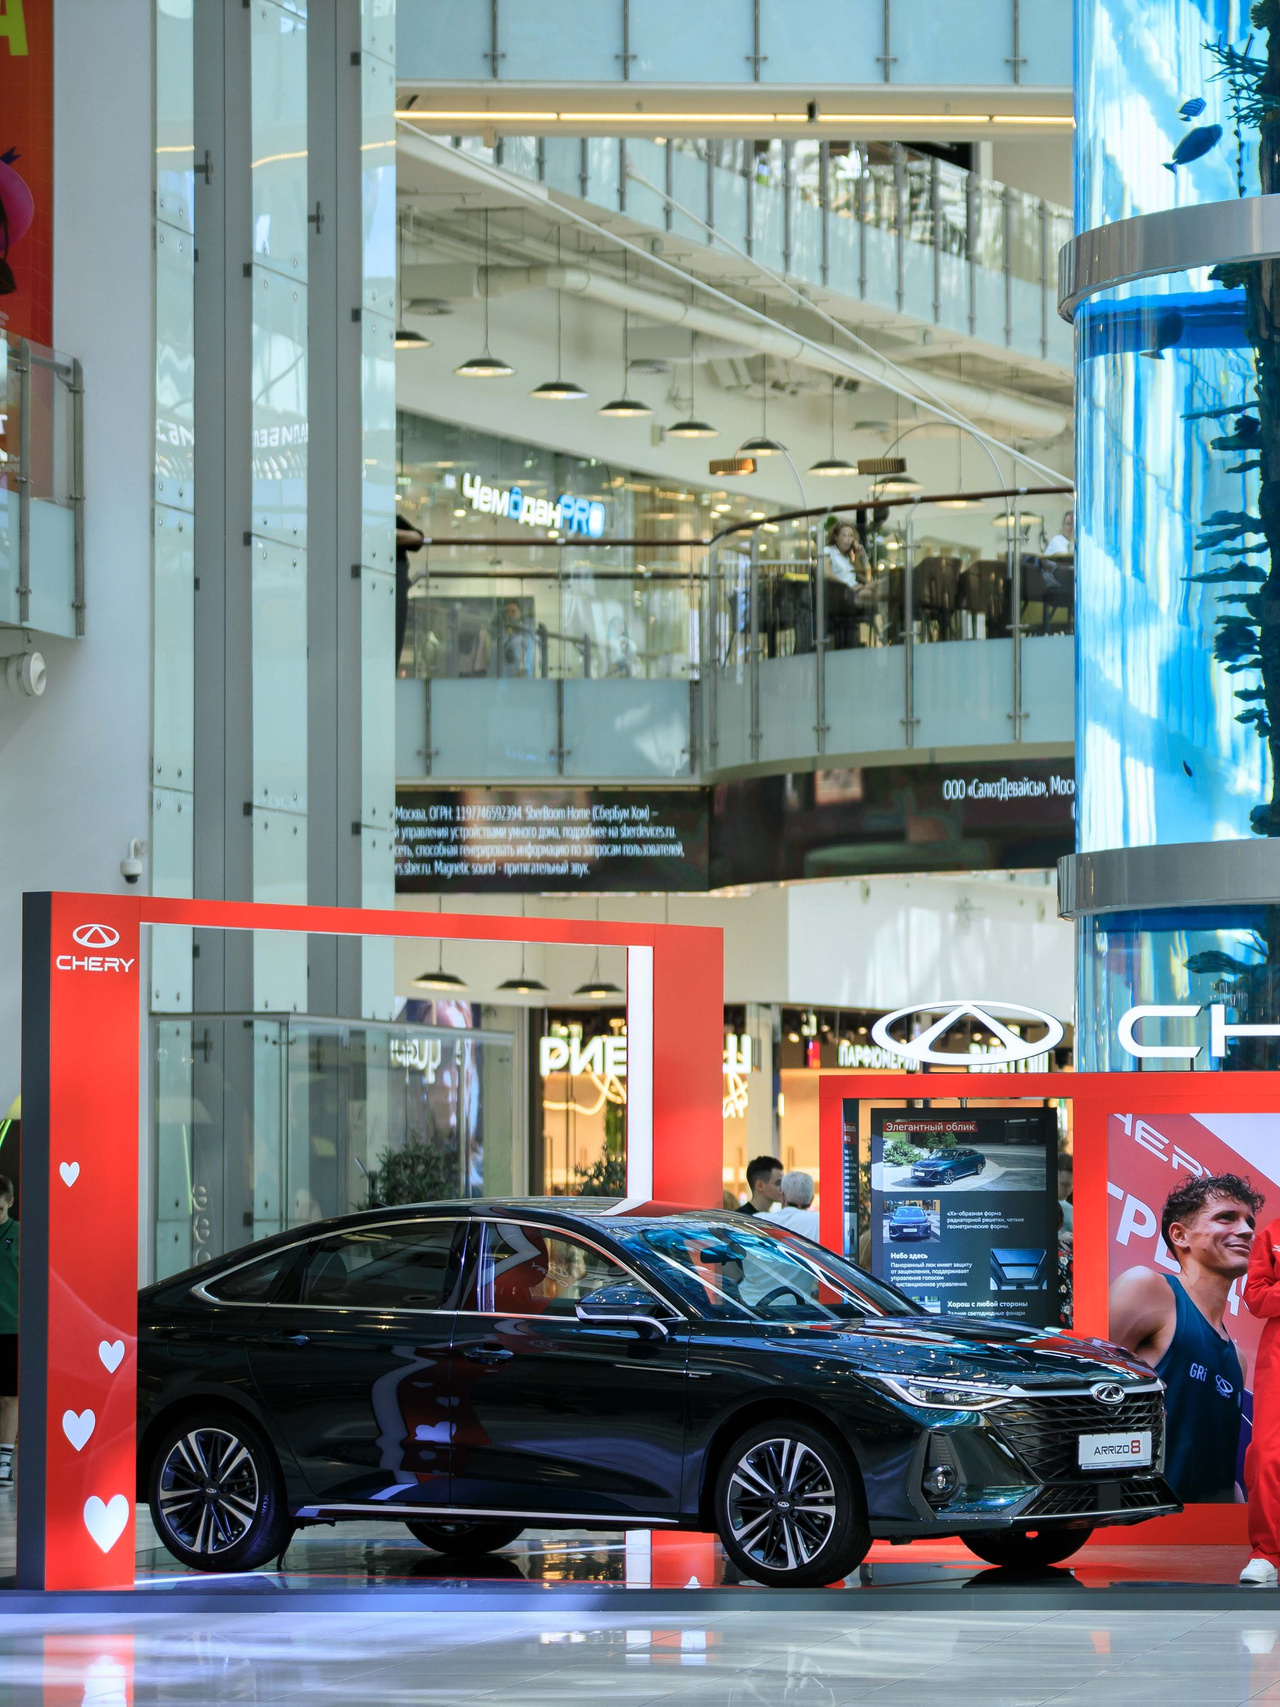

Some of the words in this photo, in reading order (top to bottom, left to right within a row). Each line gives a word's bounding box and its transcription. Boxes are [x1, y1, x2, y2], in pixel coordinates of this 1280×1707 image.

[943, 779, 965, 800] ООО
[608, 826, 618, 838] на
[472, 860, 496, 875] sound
[56, 954, 136, 973] CHERY
[886, 1122, 944, 1131] Элегантный
[946, 1122, 975, 1131] облик
[947, 1300, 971, 1309] Хорош
[977, 1300, 999, 1308] любой
[1093, 1444, 1130, 1456] ARRIZO
[1130, 1439, 1141, 1455] 8
